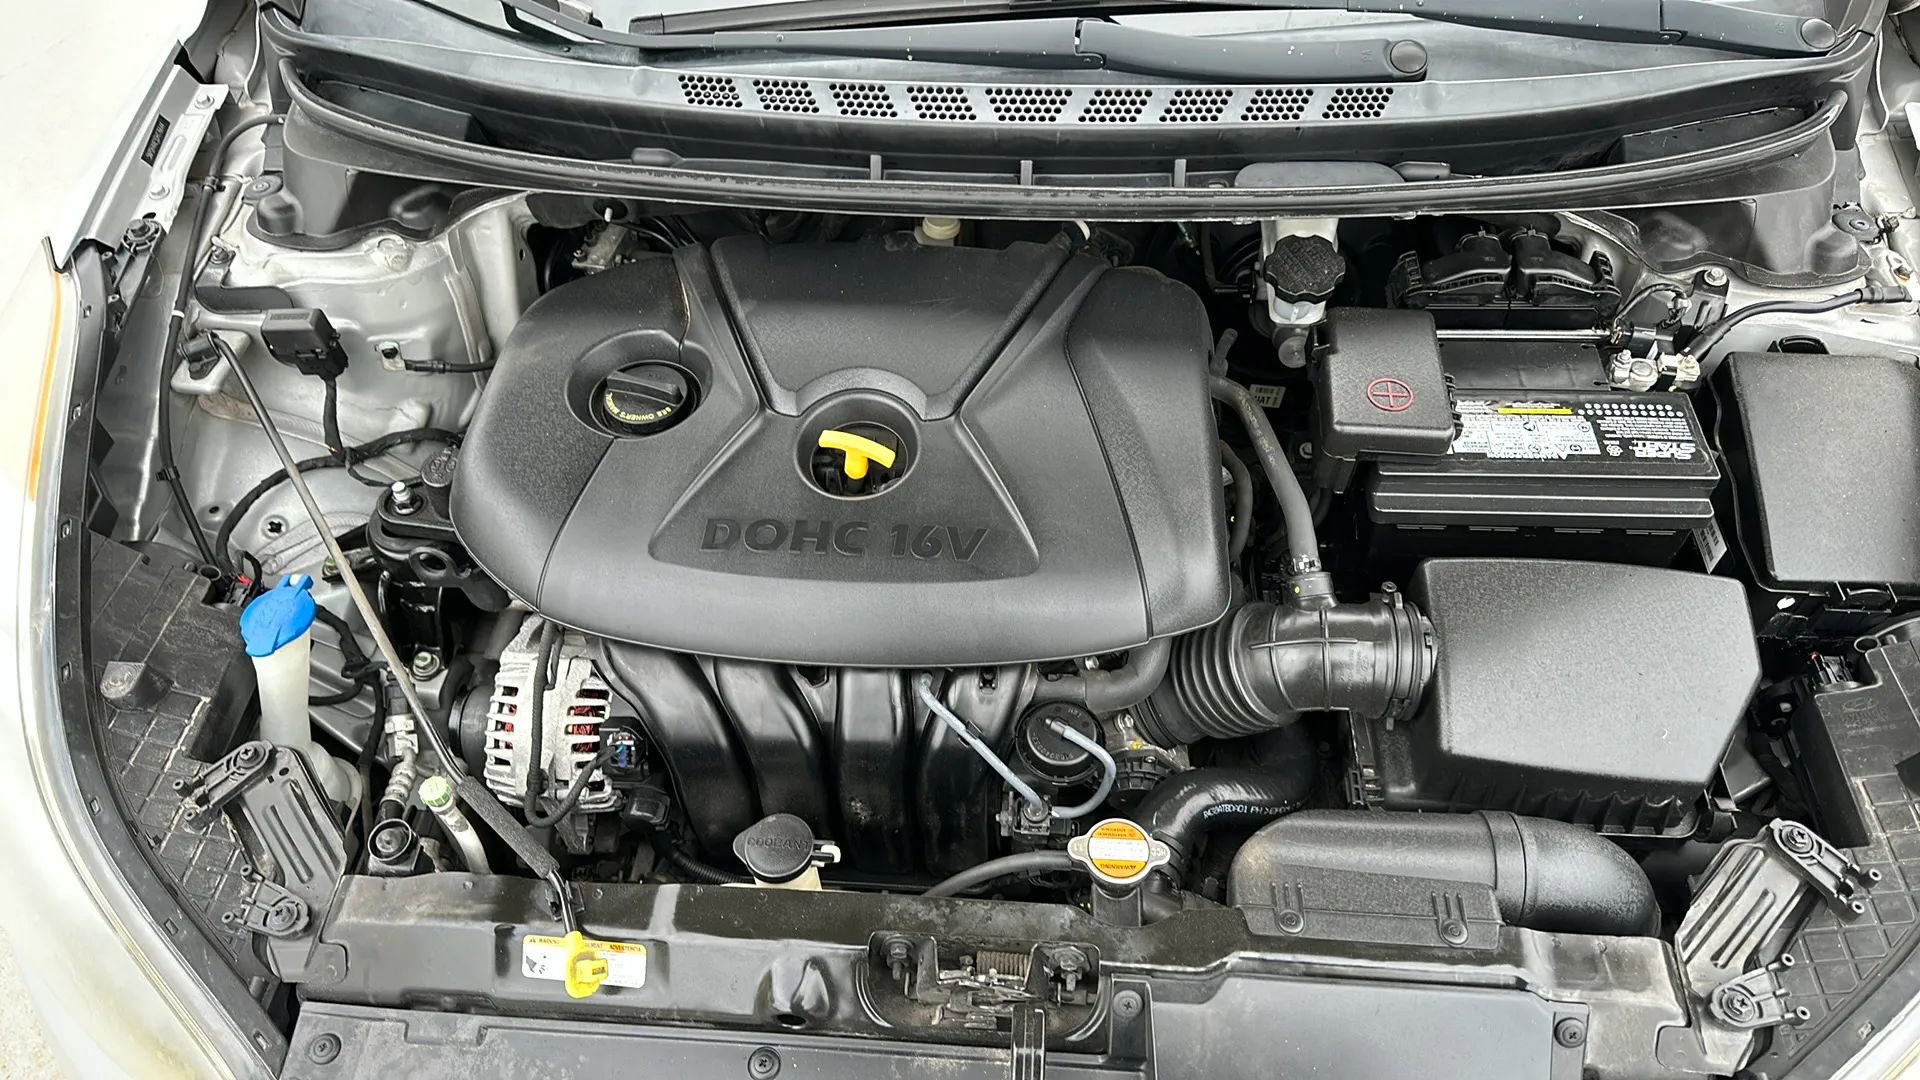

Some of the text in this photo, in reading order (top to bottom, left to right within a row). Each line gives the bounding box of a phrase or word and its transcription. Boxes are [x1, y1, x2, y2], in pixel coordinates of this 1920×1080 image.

[700, 517, 990, 562] DOHC 16V
[746, 835, 811, 851] COOLANT
